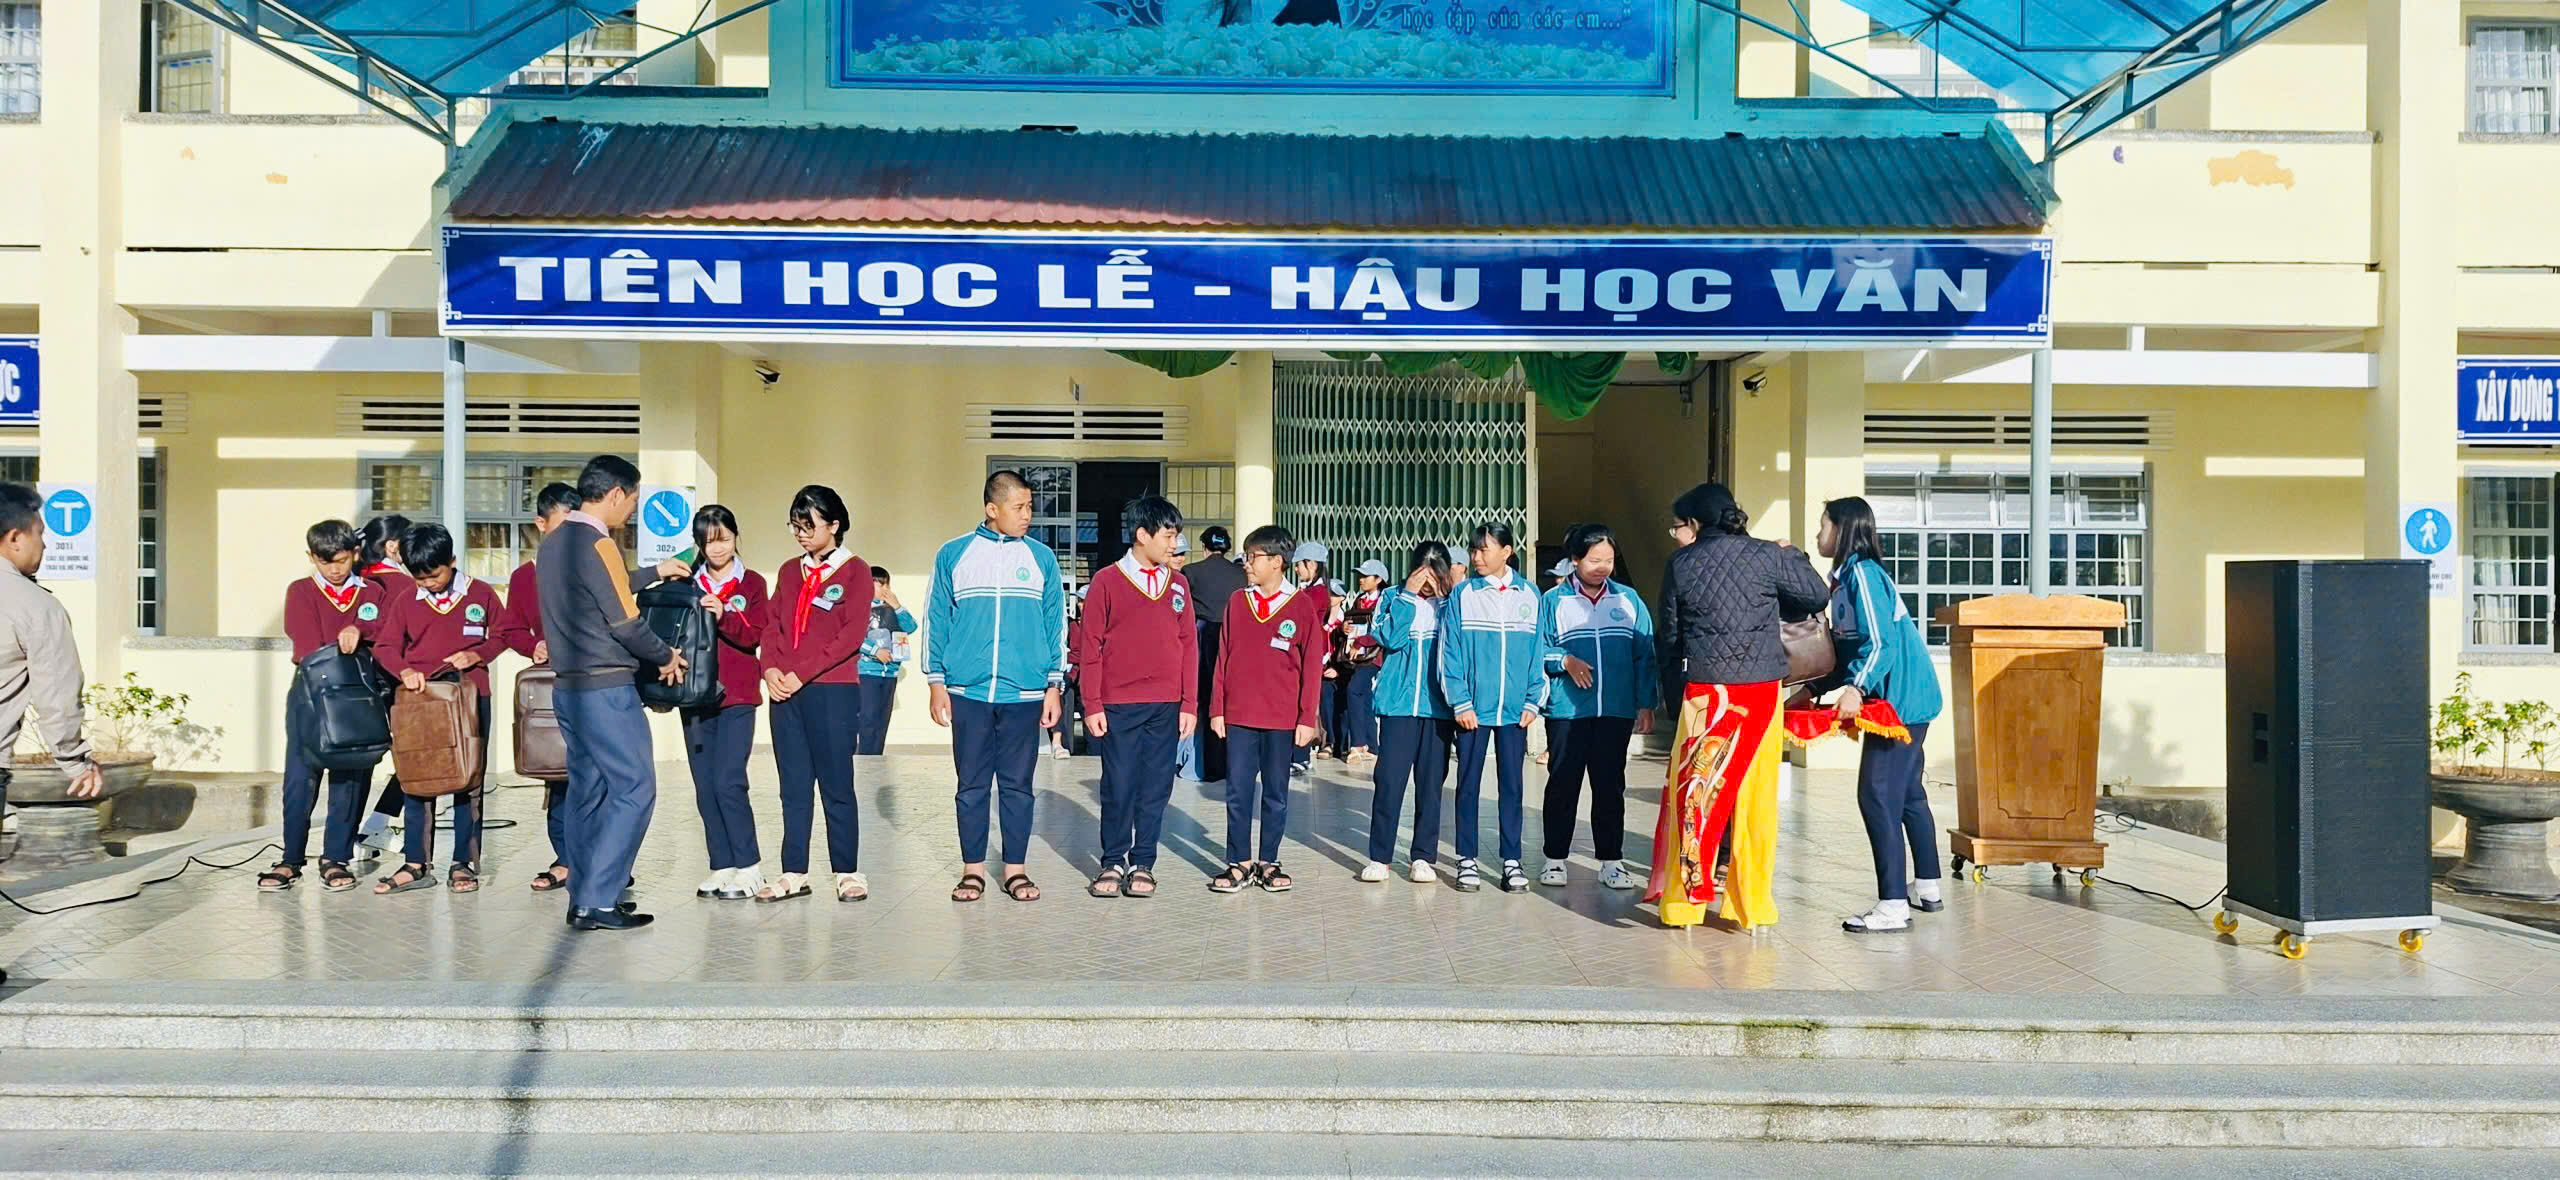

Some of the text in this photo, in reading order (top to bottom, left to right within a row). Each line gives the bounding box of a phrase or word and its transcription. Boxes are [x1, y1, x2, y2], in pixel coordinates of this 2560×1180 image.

[1401, 8, 1433, 32] học
[1446, 7, 1475, 33] tập
[1489, 7, 1521, 29] của
[1533, 6, 1563, 29] các
[498, 248, 1988, 322] TIÊN HỌC LỄ - HẬU HỌC VĂN
[2475, 370, 2507, 422] XÂY
[2510, 374, 2553, 431] DỰNG
[656, 544, 677, 552] 302a
